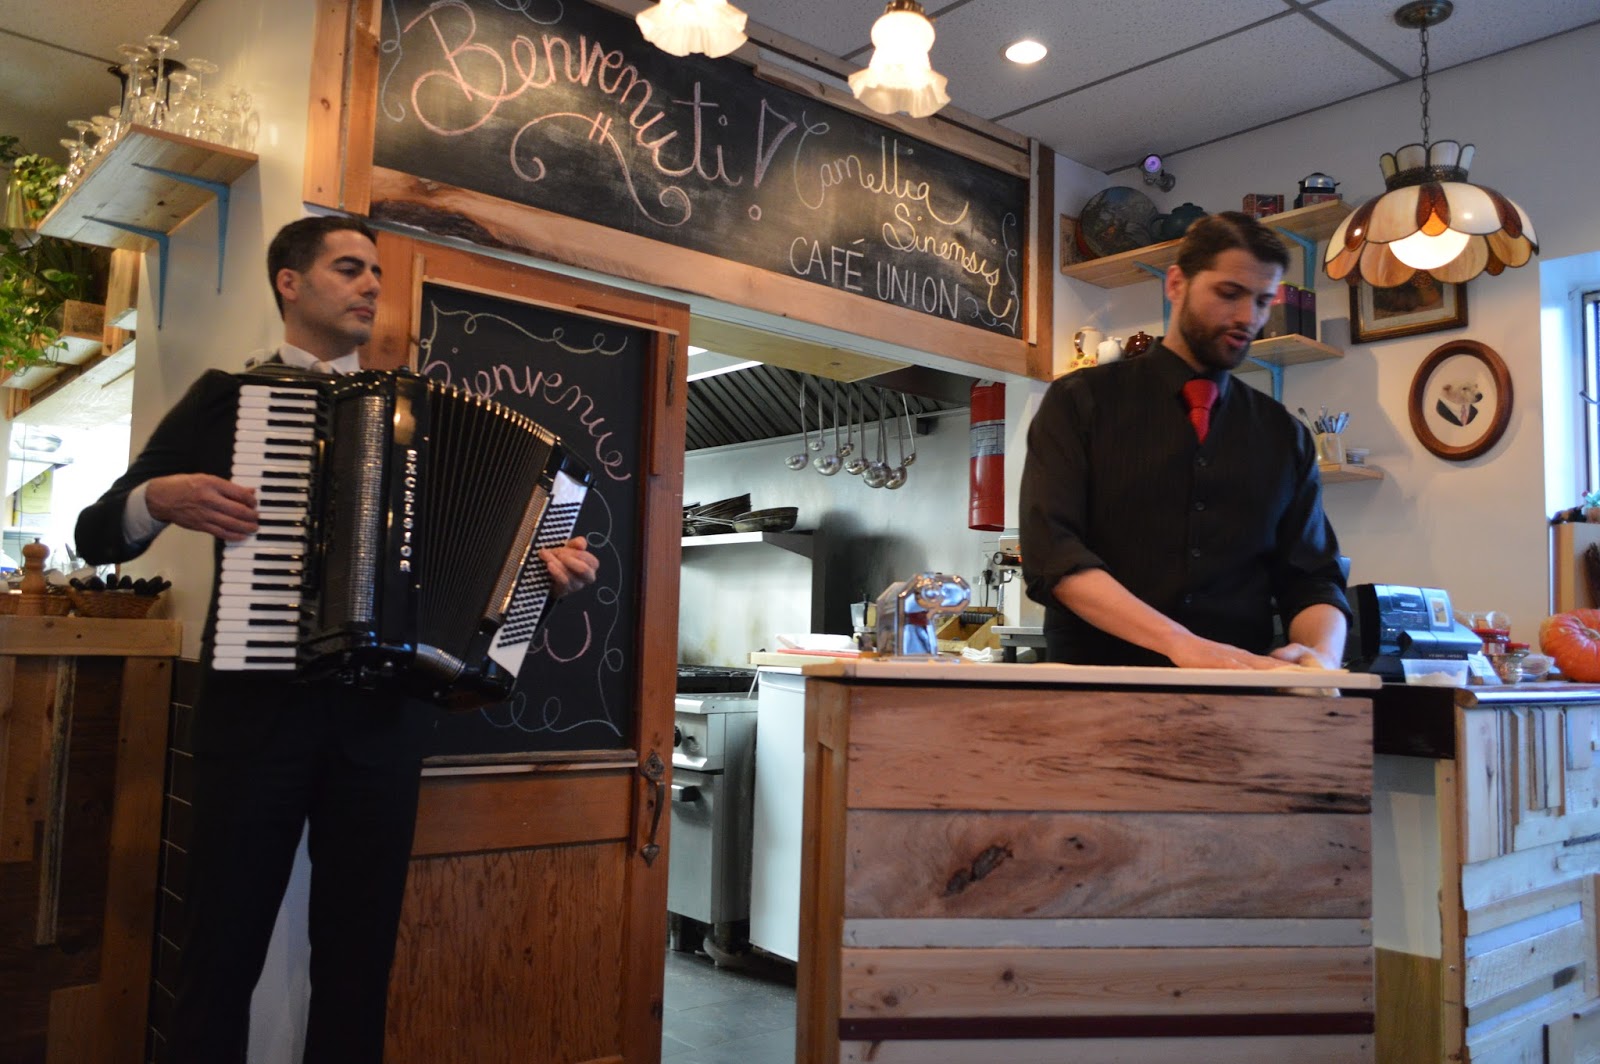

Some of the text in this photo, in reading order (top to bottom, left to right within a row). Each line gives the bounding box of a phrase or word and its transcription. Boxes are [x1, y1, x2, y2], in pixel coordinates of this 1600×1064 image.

[794, 111, 968, 225] Camellia
[789, 237, 959, 319] CAFÉ UNION
[883, 203, 1012, 318] Sinensis
[399, 449, 418, 573] EXCELSIOR
